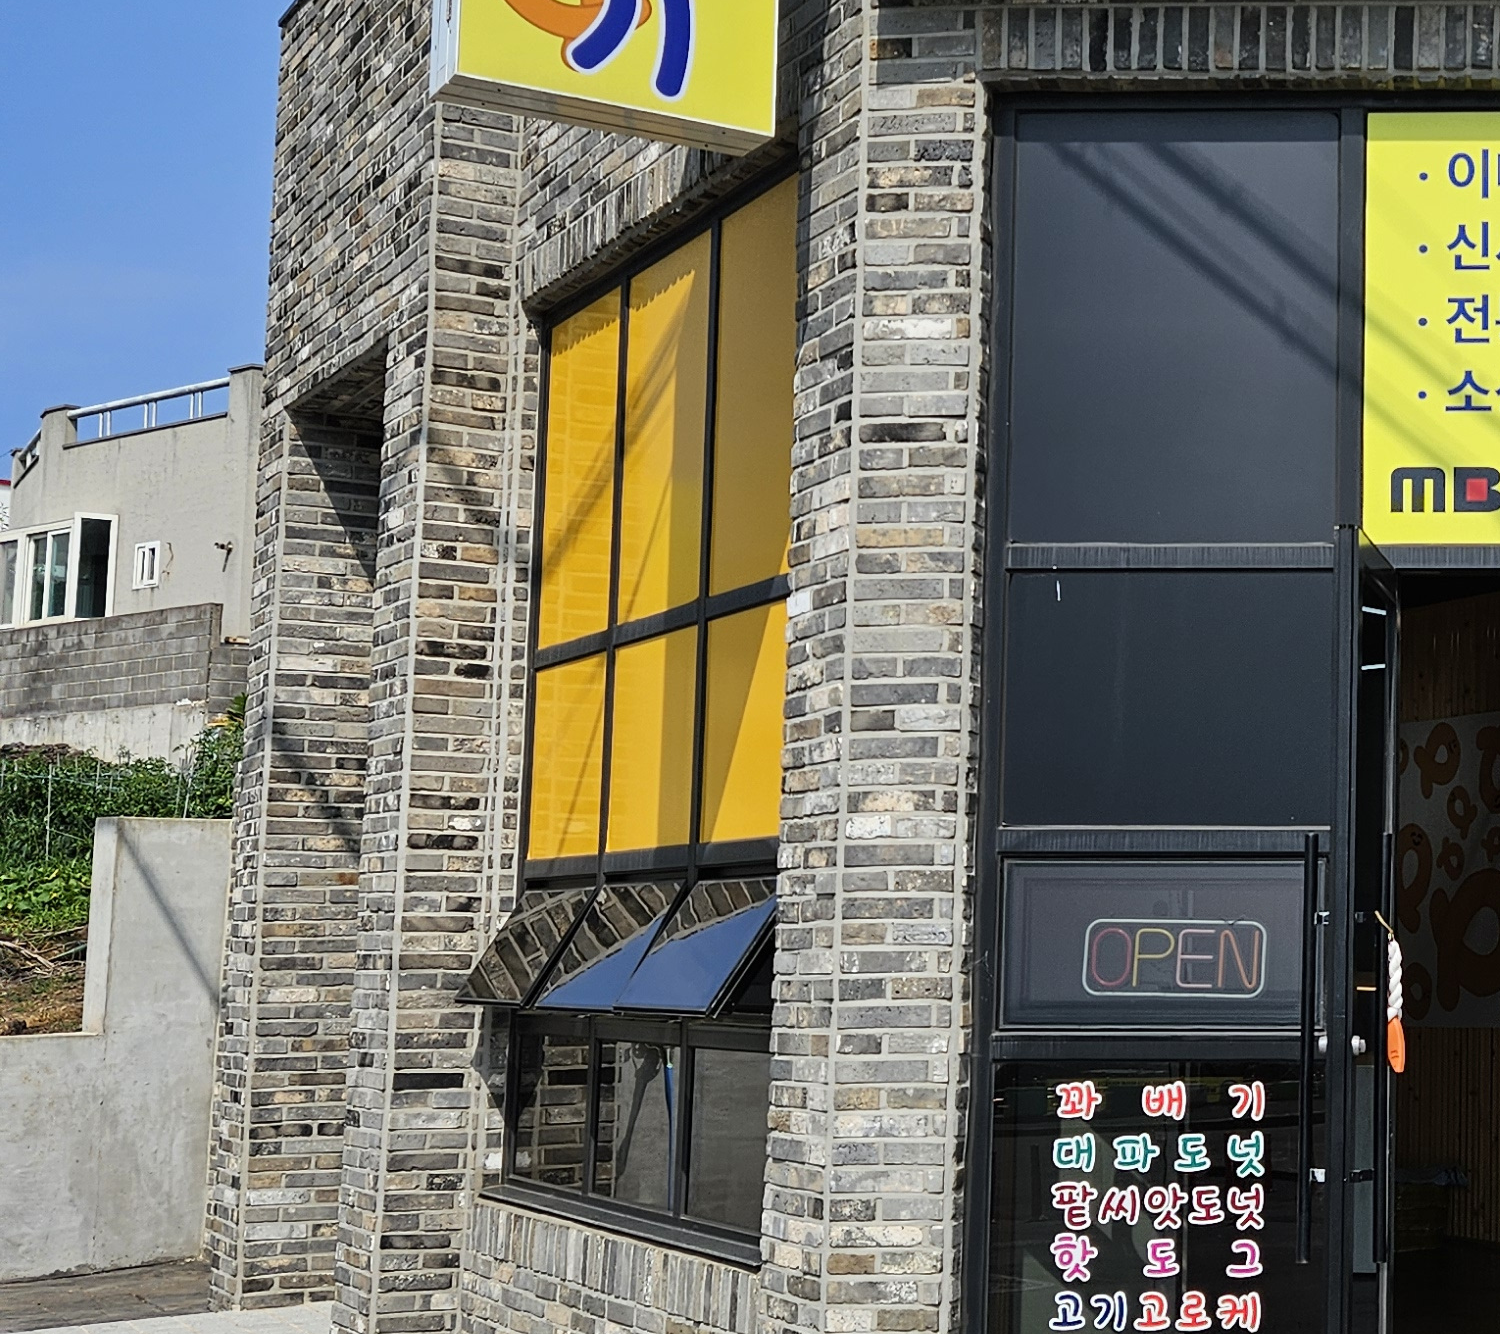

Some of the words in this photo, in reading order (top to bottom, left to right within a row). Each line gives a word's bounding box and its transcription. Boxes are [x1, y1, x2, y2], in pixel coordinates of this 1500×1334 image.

[1090, 928, 1261, 989] OPEN
[1051, 1181, 1264, 1231] 팥씨앗도넛
[1049, 1291, 1262, 1333] 고기고로케
